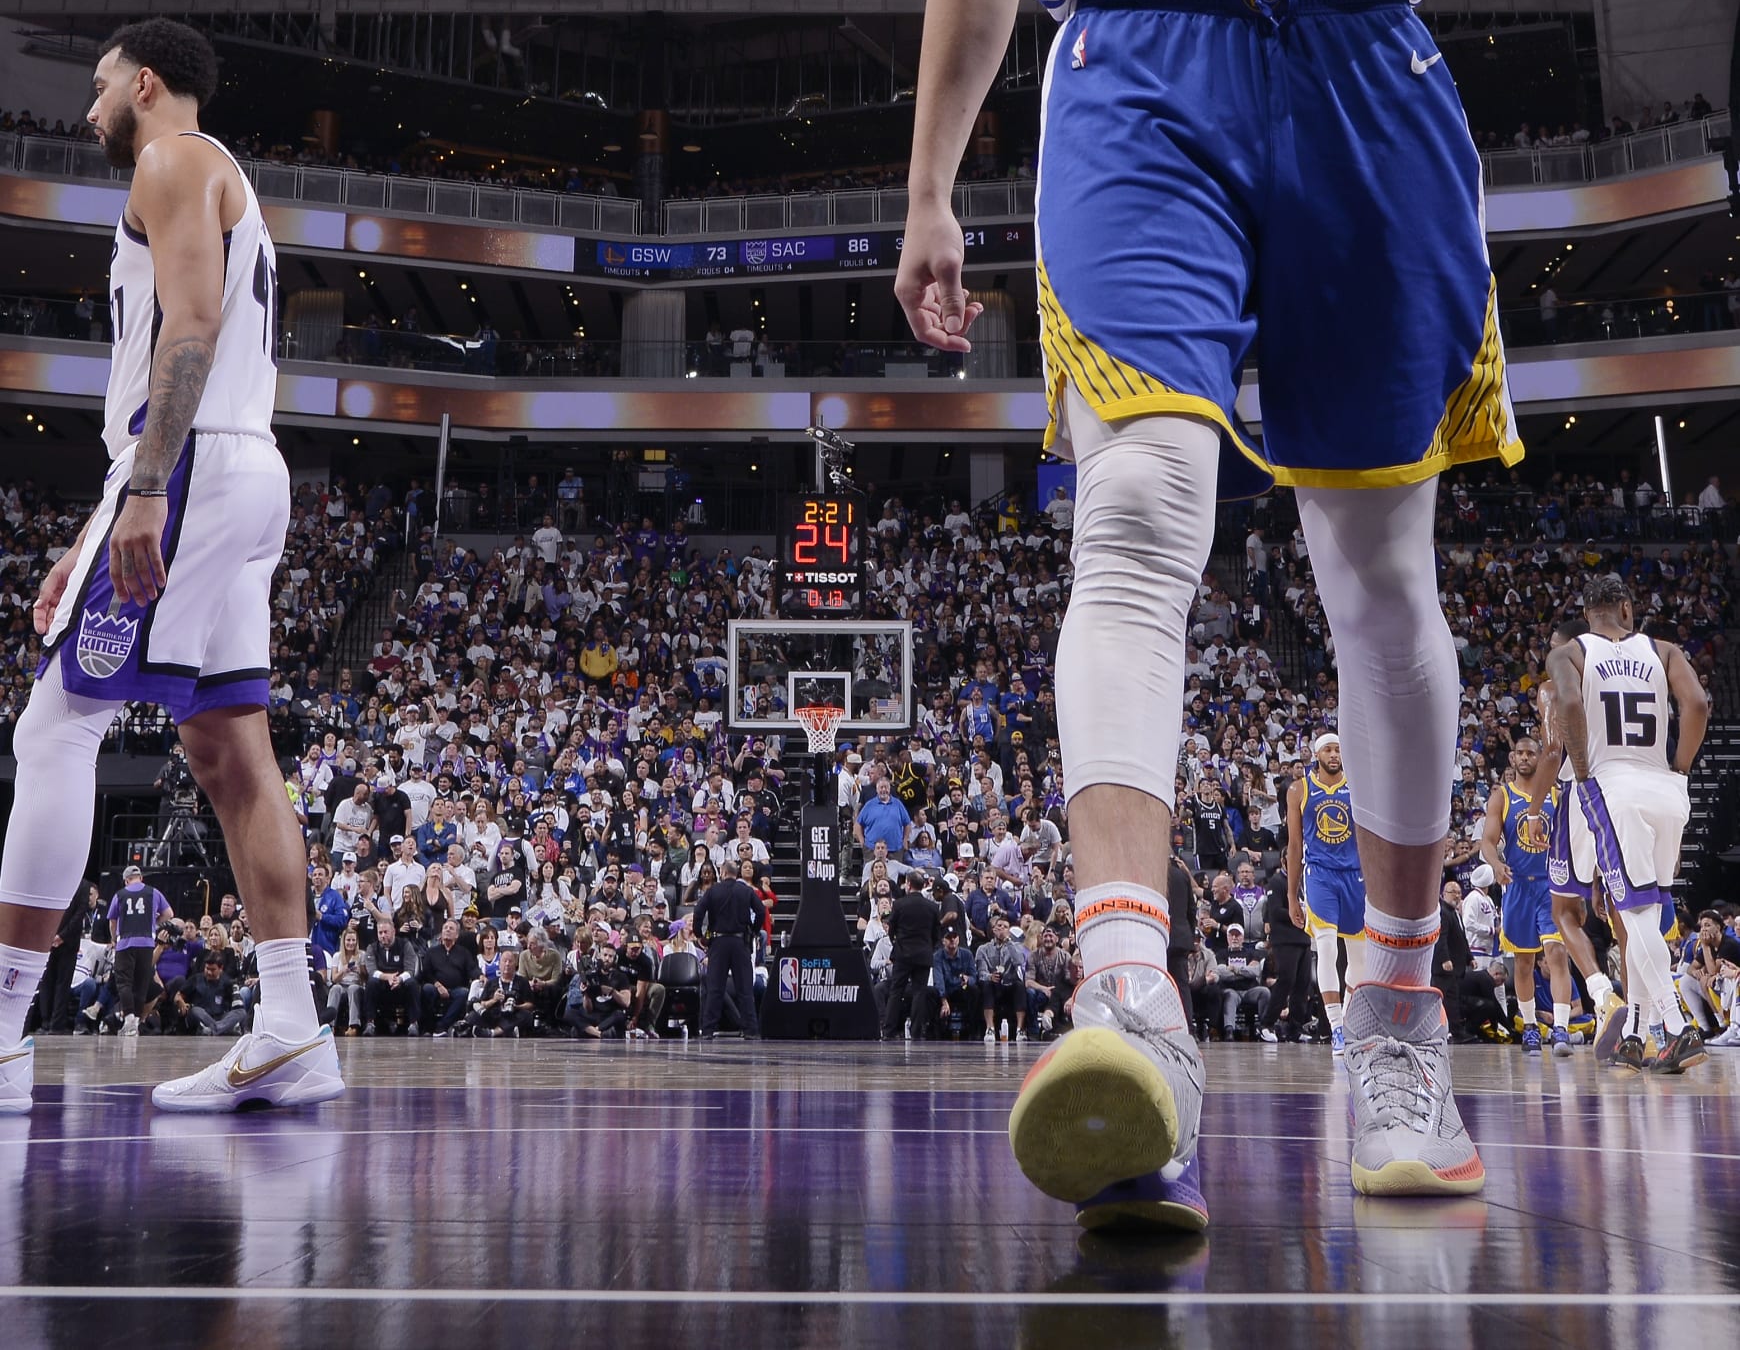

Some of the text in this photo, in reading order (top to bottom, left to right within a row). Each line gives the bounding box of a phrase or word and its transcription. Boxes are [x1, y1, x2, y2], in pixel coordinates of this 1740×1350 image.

[632, 248, 671, 263] GSW
[707, 247, 727, 262] 73
[771, 241, 806, 257] SAC
[848, 238, 869, 253] 86
[1006, 232, 1019, 241] 24
[604, 257, 878, 277] TIMEOUTS 4 FOULS 04 TIMEOUTS 4 FOULS 04
[805, 502, 852, 524] 2:21
[795, 524, 847, 563] 24
[80, 637, 129, 657] KINGS
[1595, 659, 1653, 683] MITCHELL
[1599, 691, 1657, 747] 15
[901, 788, 915, 801] 30
[1209, 819, 1215, 829] 5
[811, 826, 829, 843] GET
[811, 843, 830, 860] THE
[816, 861, 835, 881] App
[126, 897, 145, 915] 14
[801, 958, 821, 968] SoFi
[800, 968, 836, 985] PLAY-IN
[800, 985, 859, 1003] TOURNAMENT
